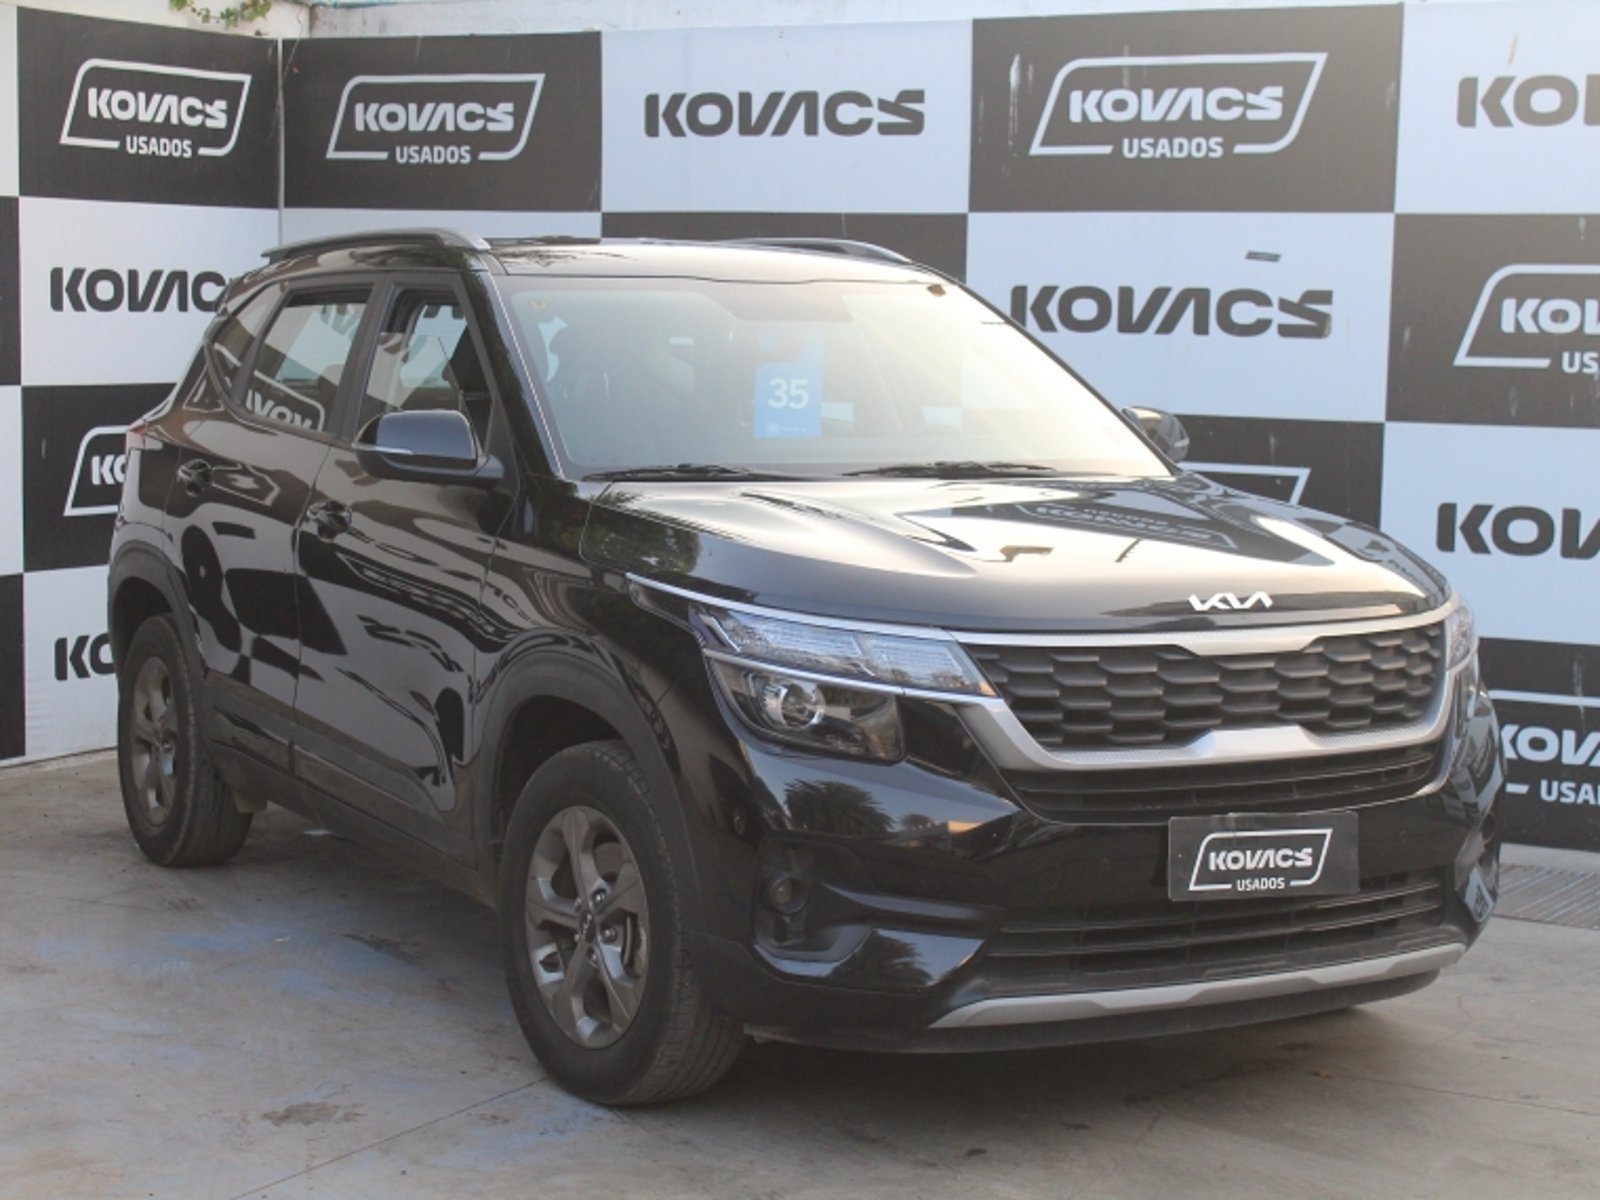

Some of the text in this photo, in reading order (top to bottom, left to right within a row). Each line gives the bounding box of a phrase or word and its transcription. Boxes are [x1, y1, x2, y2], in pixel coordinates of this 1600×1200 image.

[88, 87, 228, 129] KOVACS
[644, 89, 926, 138] KOVACS
[1069, 85, 1284, 123] KOVACS
[1456, 73, 1600, 128] KO
[355, 102, 514, 132] KOVACS
[126, 134, 193, 159] USADOS
[395, 145, 471, 165] USADOS
[1122, 136, 1224, 159] USADOS
[50, 266, 226, 313] KOVAC
[1010, 284, 1334, 339] KOVACS
[767, 376, 809, 410] 35
[1187, 590, 1274, 612] KIA
[1500, 723, 1600, 768] OV
[1540, 778, 1600, 806] USA
[1208, 846, 1313, 872] KOVACS
[1236, 876, 1286, 892] USADOS
